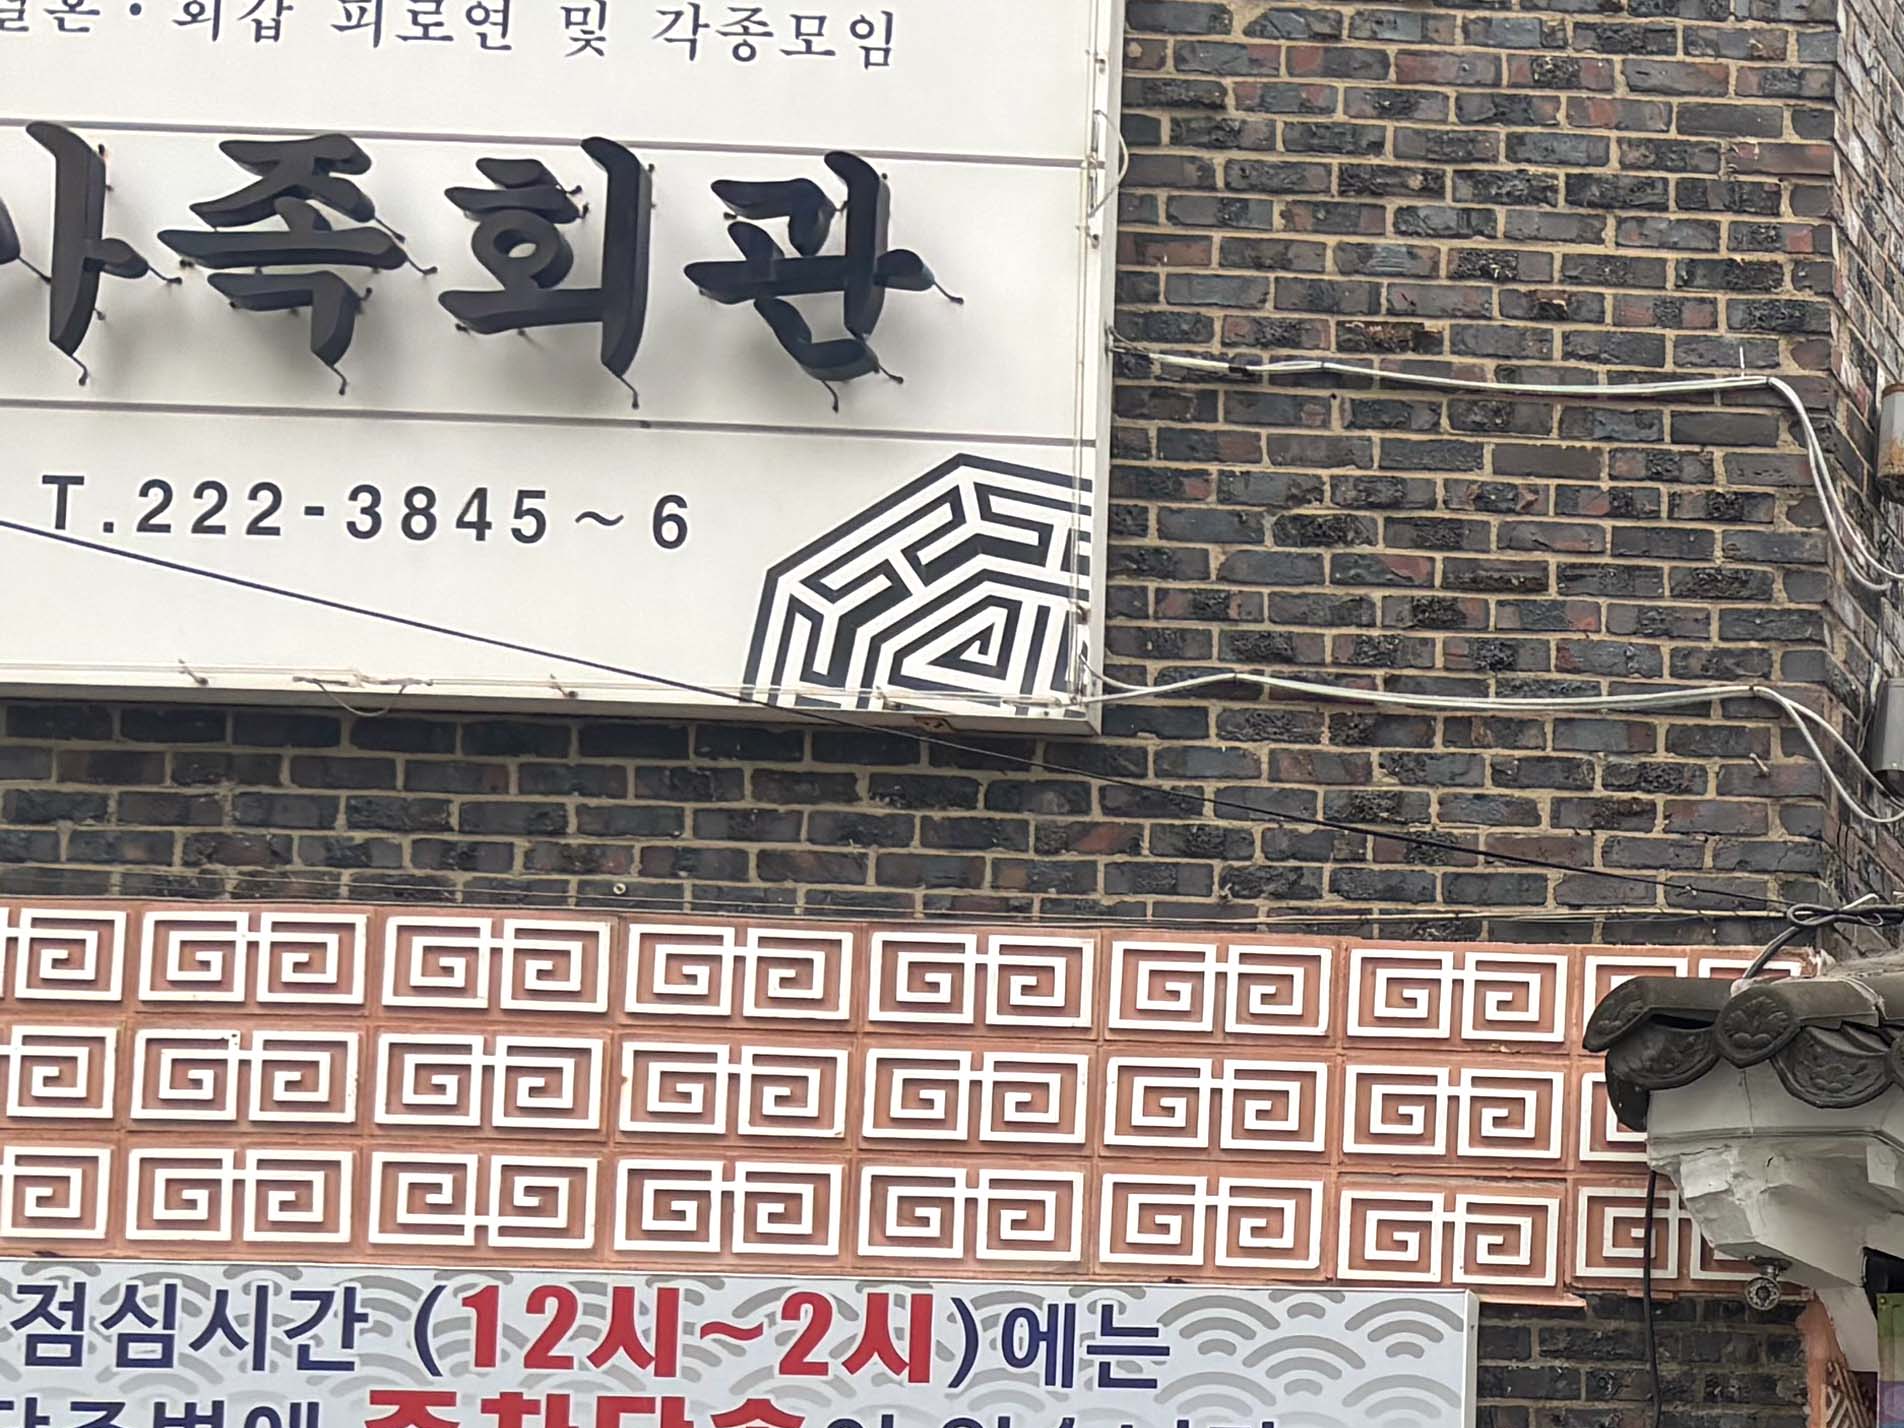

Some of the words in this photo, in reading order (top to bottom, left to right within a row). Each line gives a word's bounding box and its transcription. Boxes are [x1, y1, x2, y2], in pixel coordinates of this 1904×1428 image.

[330, 0, 513, 51] 피로연
[559, 0, 608, 58] 및
[651, 0, 896, 70] 각종모임
[9, 1281, 368, 1373] 점심시간
